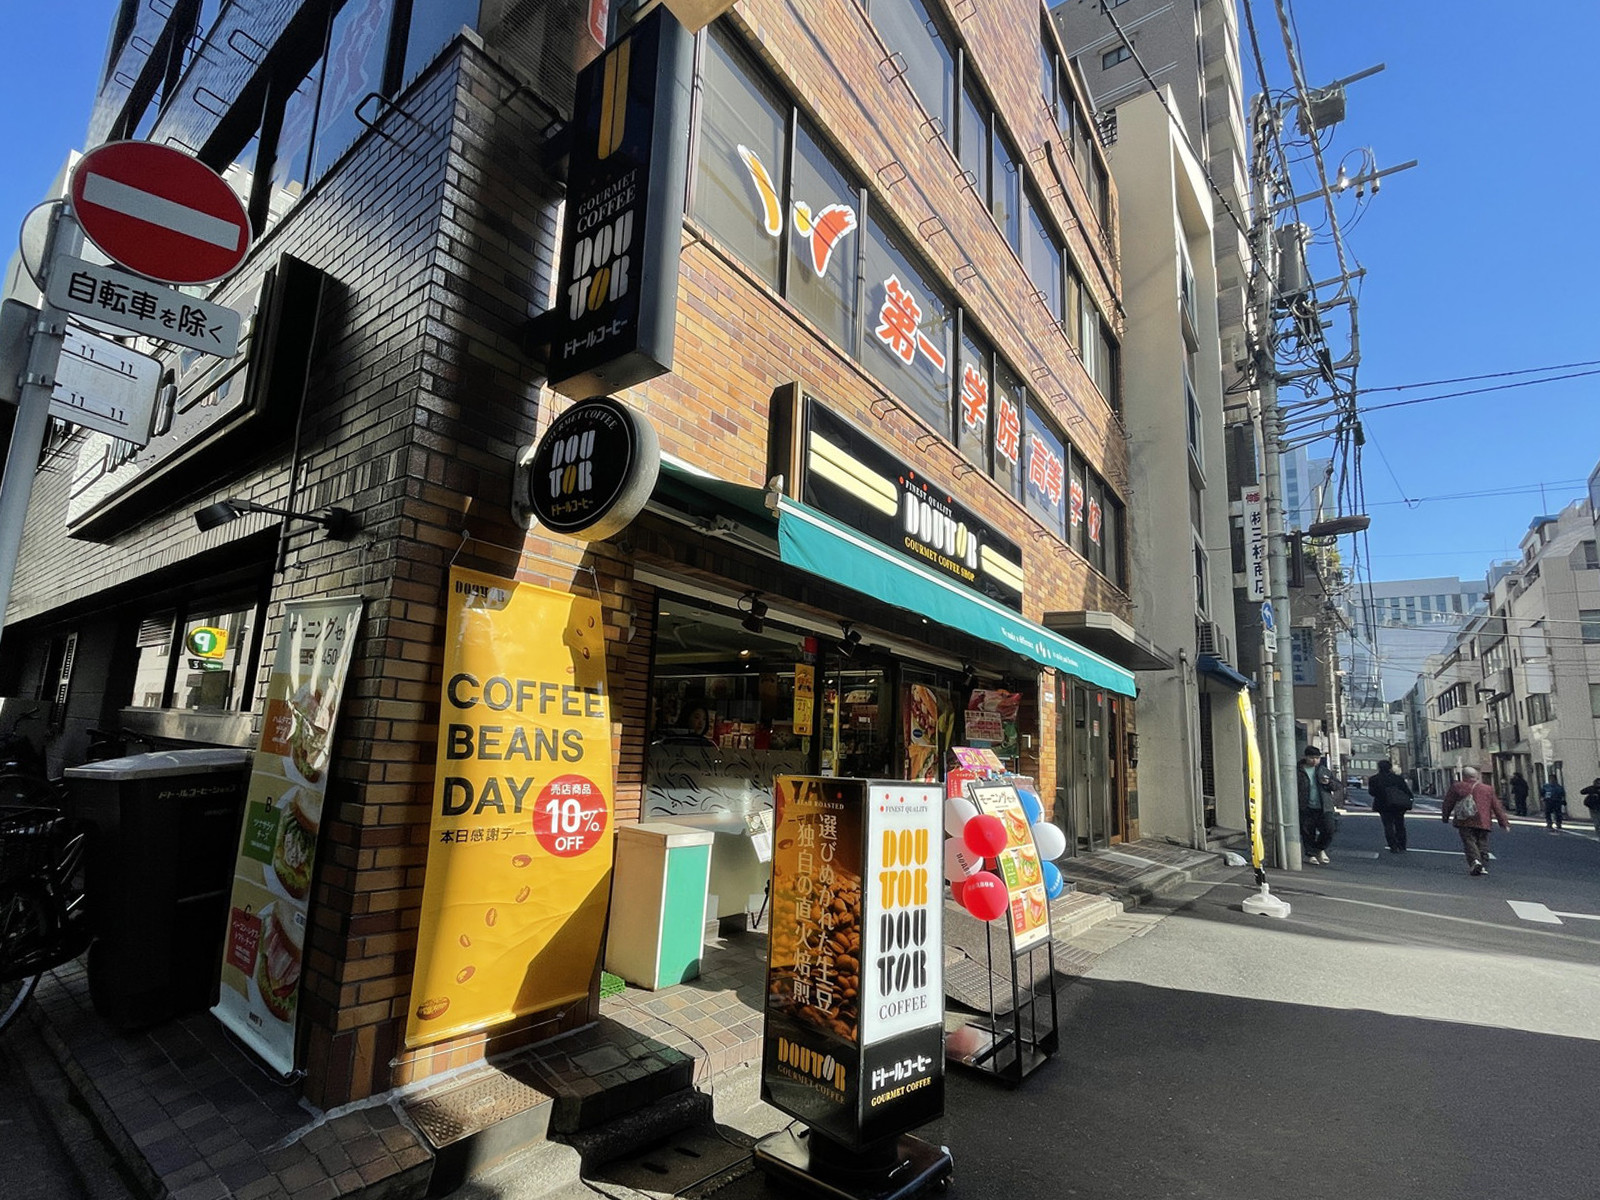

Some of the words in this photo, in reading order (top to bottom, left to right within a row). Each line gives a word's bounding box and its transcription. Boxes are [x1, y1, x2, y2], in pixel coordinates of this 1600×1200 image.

[577, 184, 636, 233] COFFEE
[579, 168, 637, 215] GOURMET
[573, 210, 634, 280] DOU
[67, 270, 224, 344] 自転車を除く
[568, 255, 630, 321] TOR
[563, 318, 628, 359] ドトールコーヒー
[584, 409, 618, 431] COFFEE
[552, 430, 596, 468] DOU
[549, 460, 593, 498] TOR
[905, 479, 927, 501] FINEST
[928, 495, 953, 518] QUALITY
[551, 498, 594, 517] ドトールコーヒー
[904, 491, 978, 570] DOUTOR
[904, 536, 938, 563] GOURMET
[938, 555, 961, 576] COFFEE
[961, 567, 976, 582] SHOP
[447, 673, 606, 719] COFFEE
[446, 724, 584, 762] BEANS
[441, 776, 535, 816] DAY
[550, 783, 592, 796] 売店商品
[885, 804, 904, 814] FINEST
[905, 804, 928, 814] QUALITY
[440, 827, 528, 844] 本日感謝デー
[545, 799, 601, 834] 10%
[555, 835, 584, 851] OFF
[882, 828, 928, 868] DOU
[879, 868, 928, 910] TOR
[792, 823, 814, 1006] 独自の直火焙煎
[815, 813, 838, 1016] 選びぬかれた生豆
[880, 909, 927, 953] DOU
[877, 949, 927, 997] TOR
[879, 995, 927, 1020] COFFEE
[778, 1036, 846, 1092] DOUTOR
[871, 1054, 932, 1090] ドトールコーヒー
[815, 1083, 845, 1105] COFFEE
[871, 1086, 906, 1107] GOURMET
[906, 1076, 932, 1093] COFFEE
